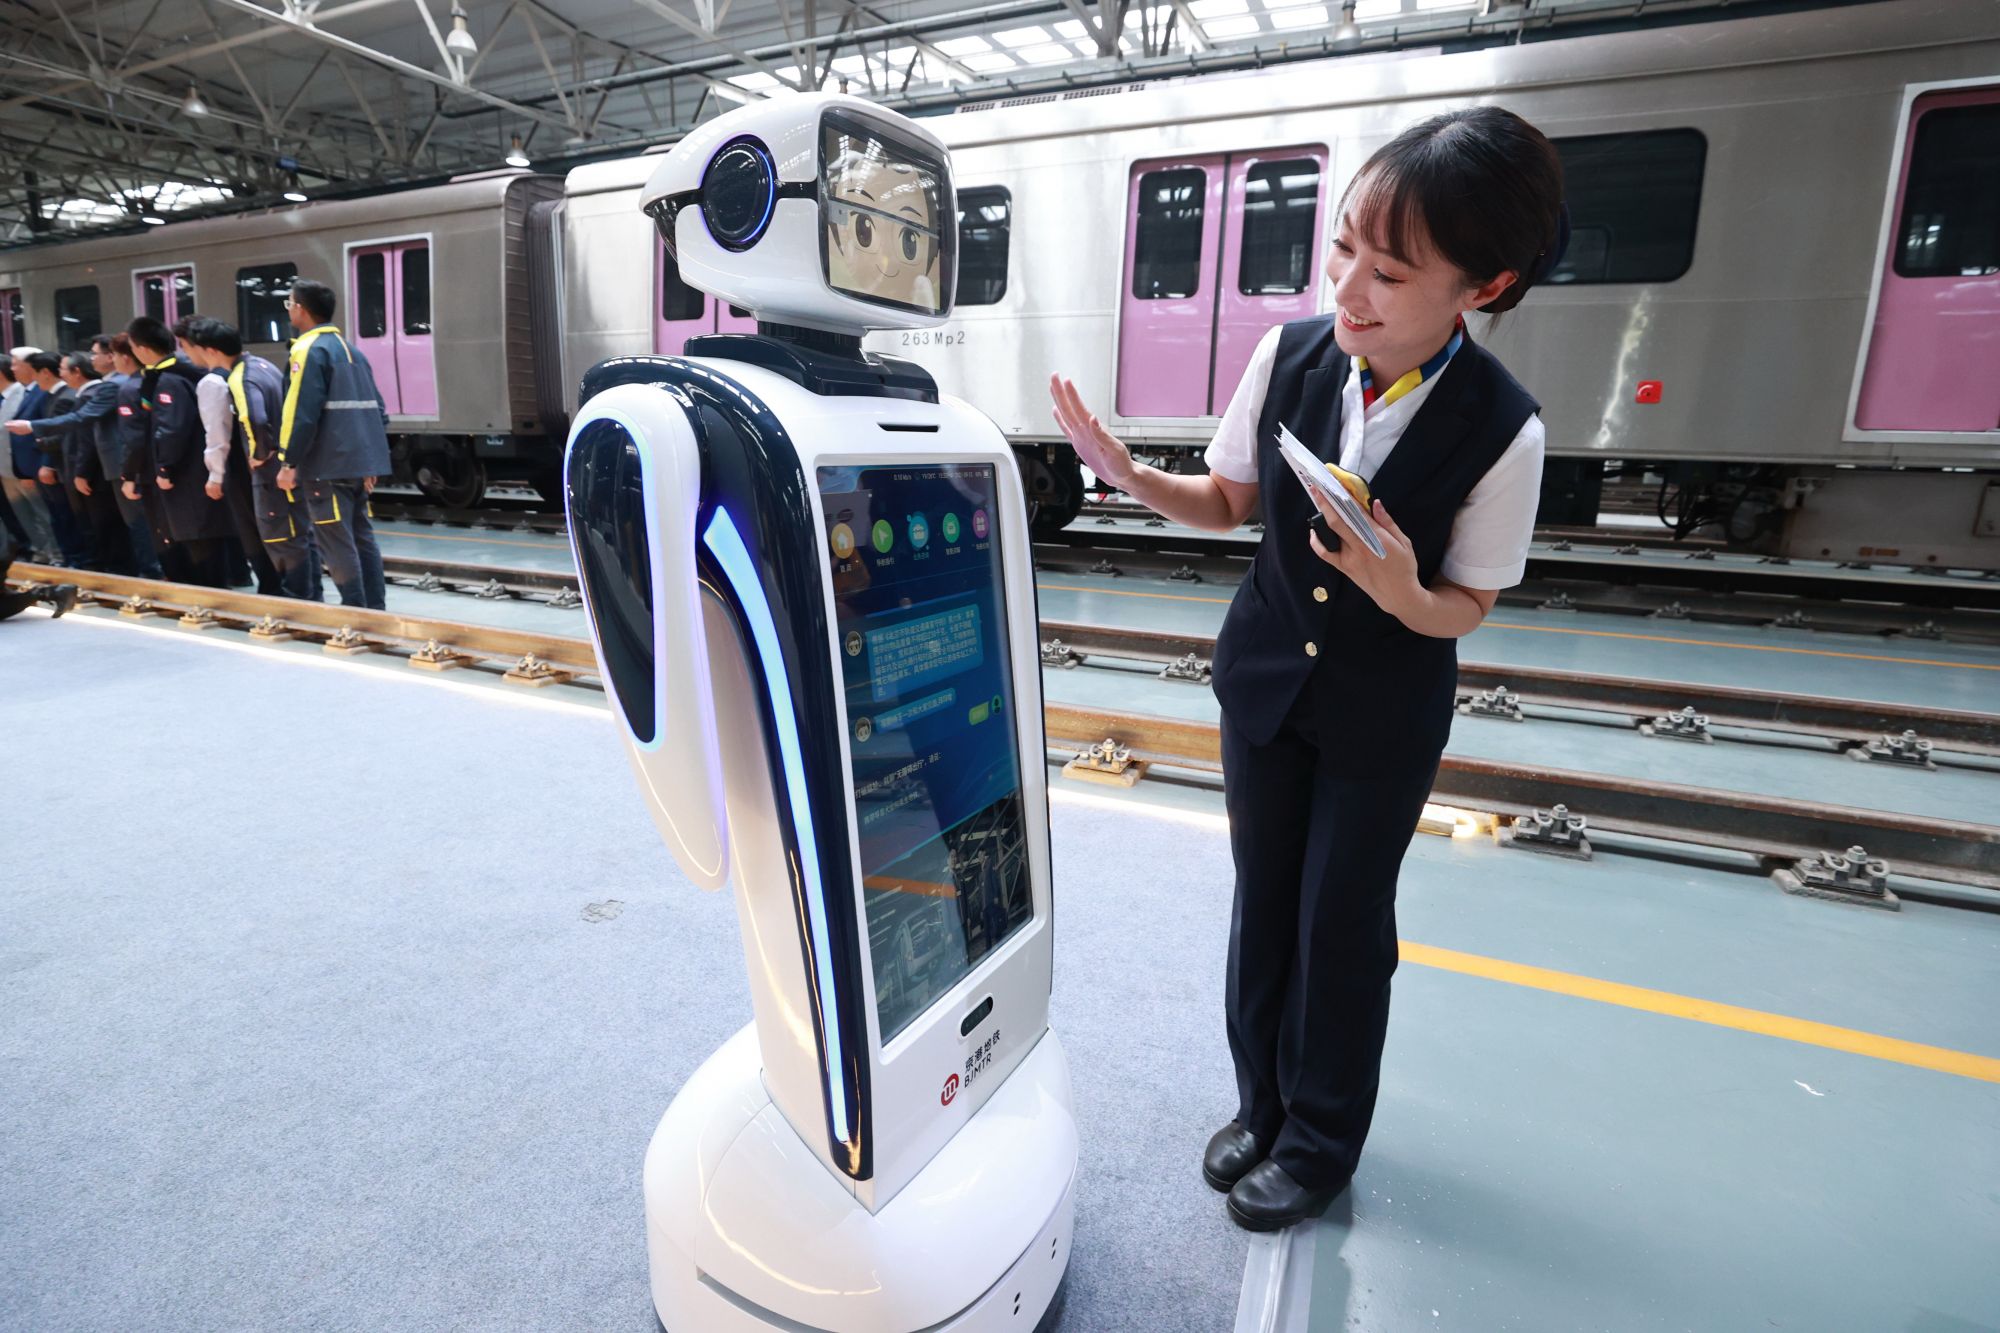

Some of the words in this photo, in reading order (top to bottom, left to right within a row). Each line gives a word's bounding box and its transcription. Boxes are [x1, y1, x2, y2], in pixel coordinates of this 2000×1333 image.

[902, 331, 930, 346] 263
[965, 1029, 1000, 1073] 京港地铁
[964, 1052, 992, 1088] BJMTR
